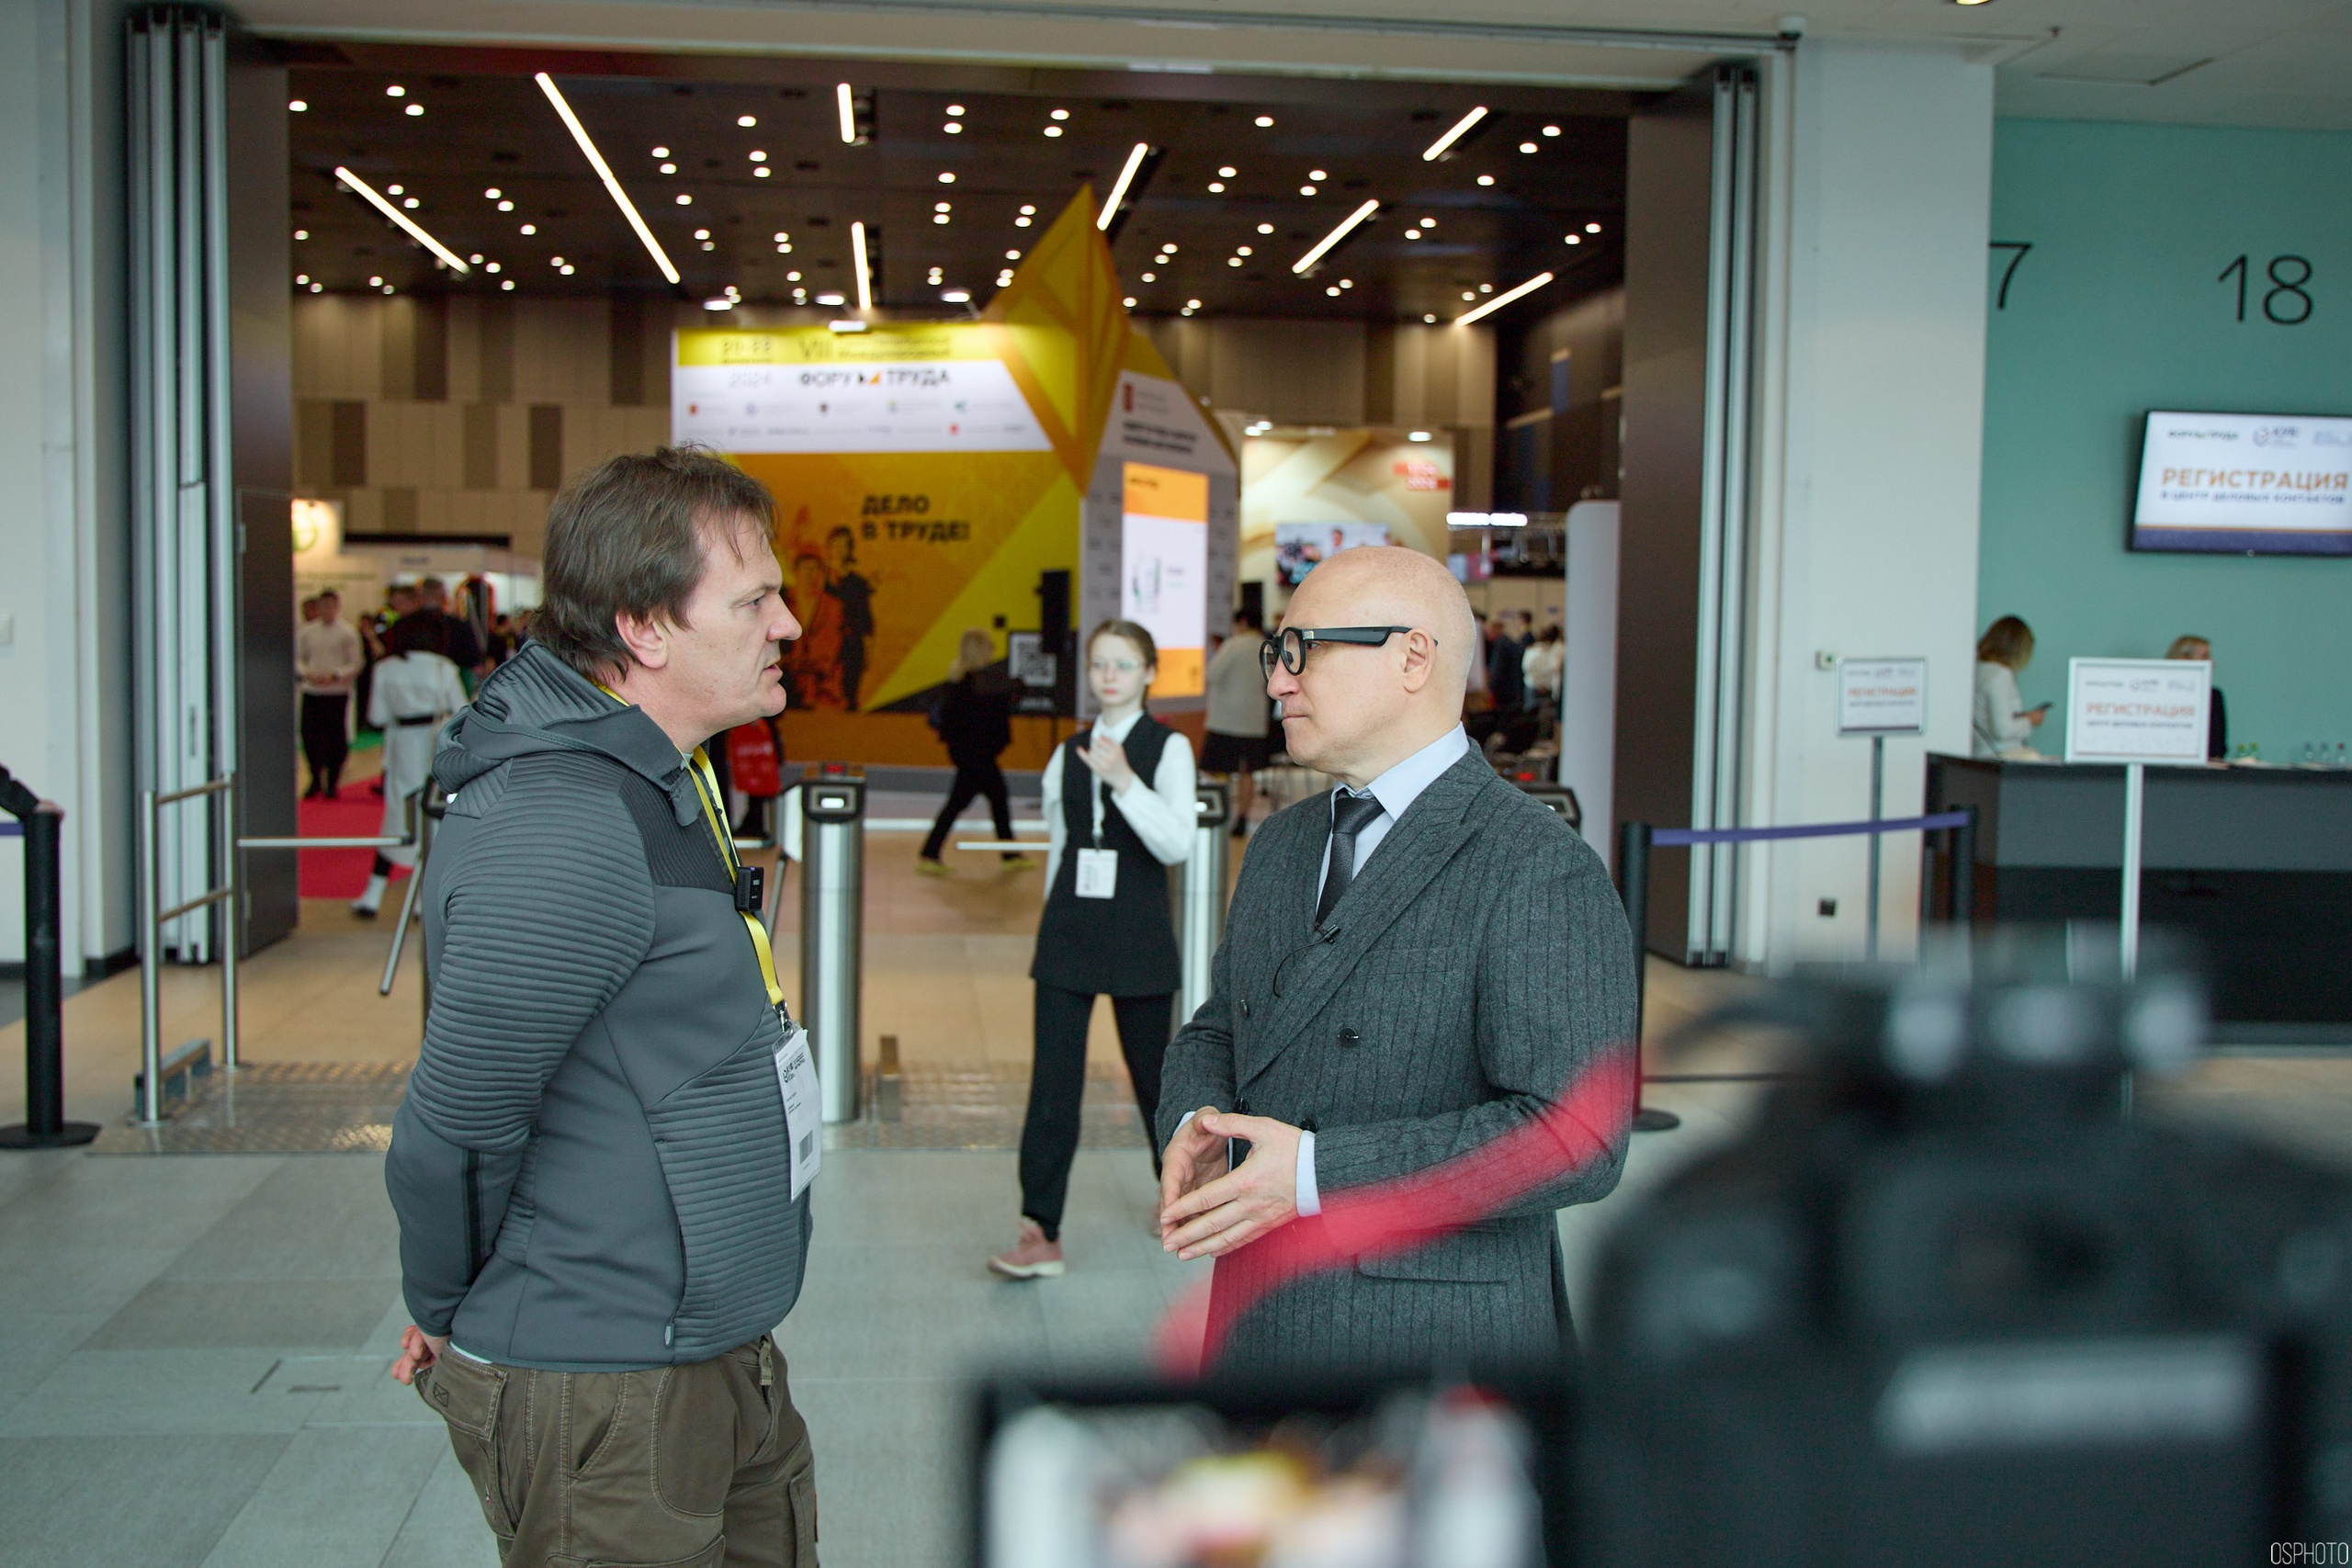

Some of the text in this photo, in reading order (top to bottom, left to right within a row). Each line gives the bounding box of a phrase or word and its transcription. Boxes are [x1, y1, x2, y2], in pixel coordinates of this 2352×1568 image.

[2217, 254, 2313, 325] 18
[887, 369, 951, 387] ТРУДА
[2162, 468, 2348, 493] РЕГИСТРАЦИЯ
[862, 495, 930, 515] ДЕЛО
[863, 521, 877, 540] В
